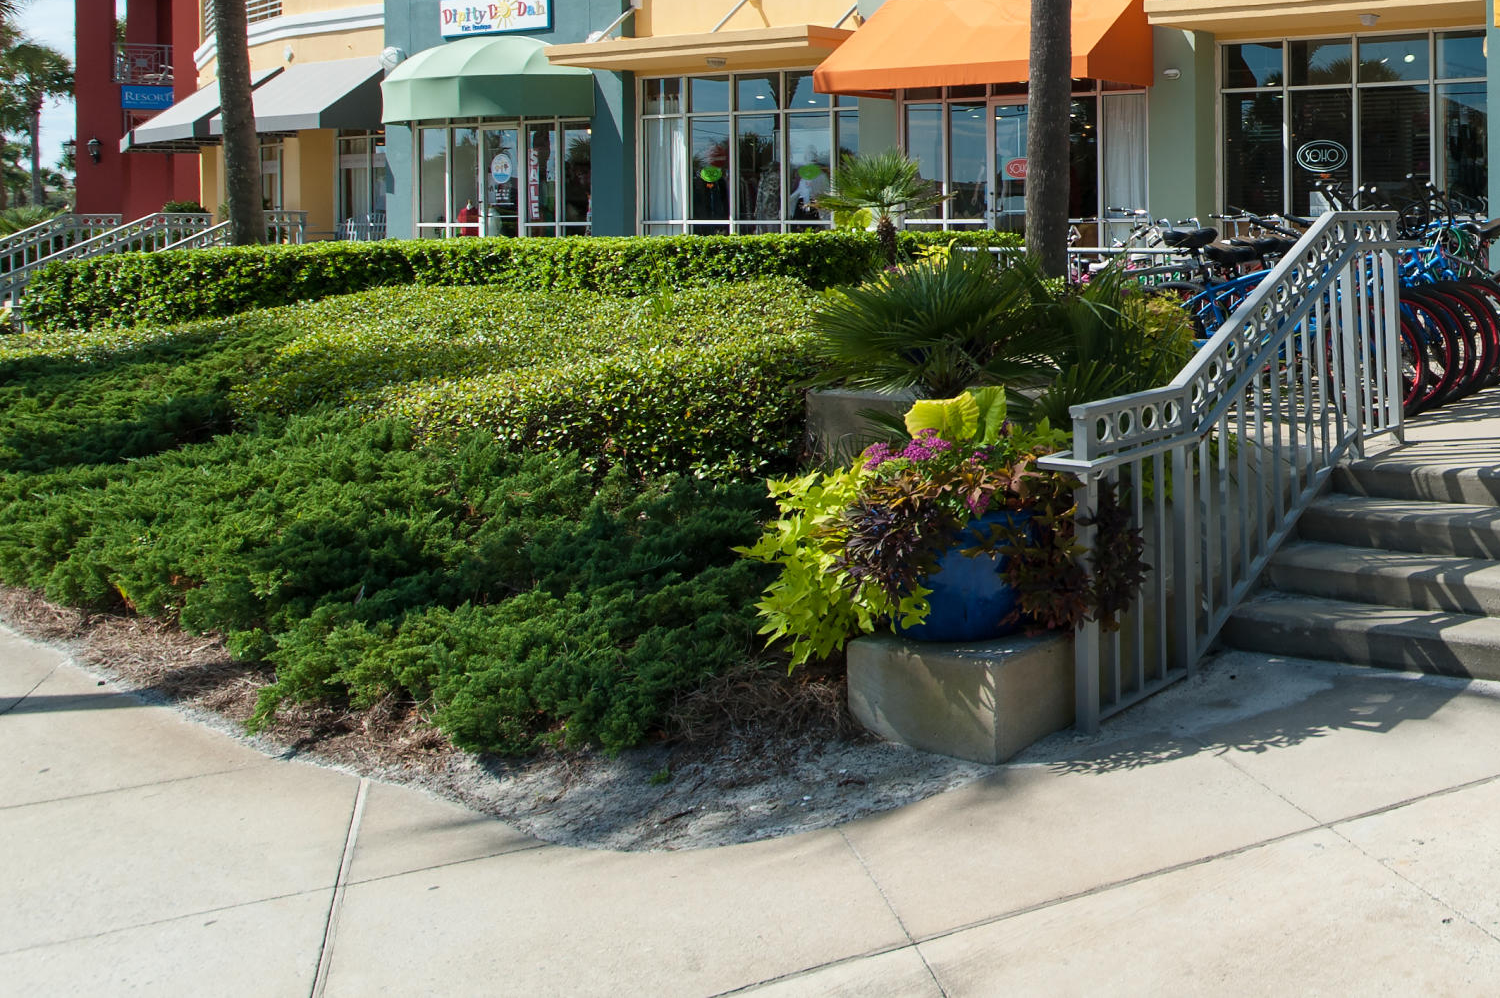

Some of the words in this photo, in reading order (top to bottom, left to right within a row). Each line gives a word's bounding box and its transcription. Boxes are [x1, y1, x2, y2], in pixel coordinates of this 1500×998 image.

[517, 0, 546, 17] Dah
[1305, 148, 1339, 163] SOHO
[529, 149, 540, 219] SALE
